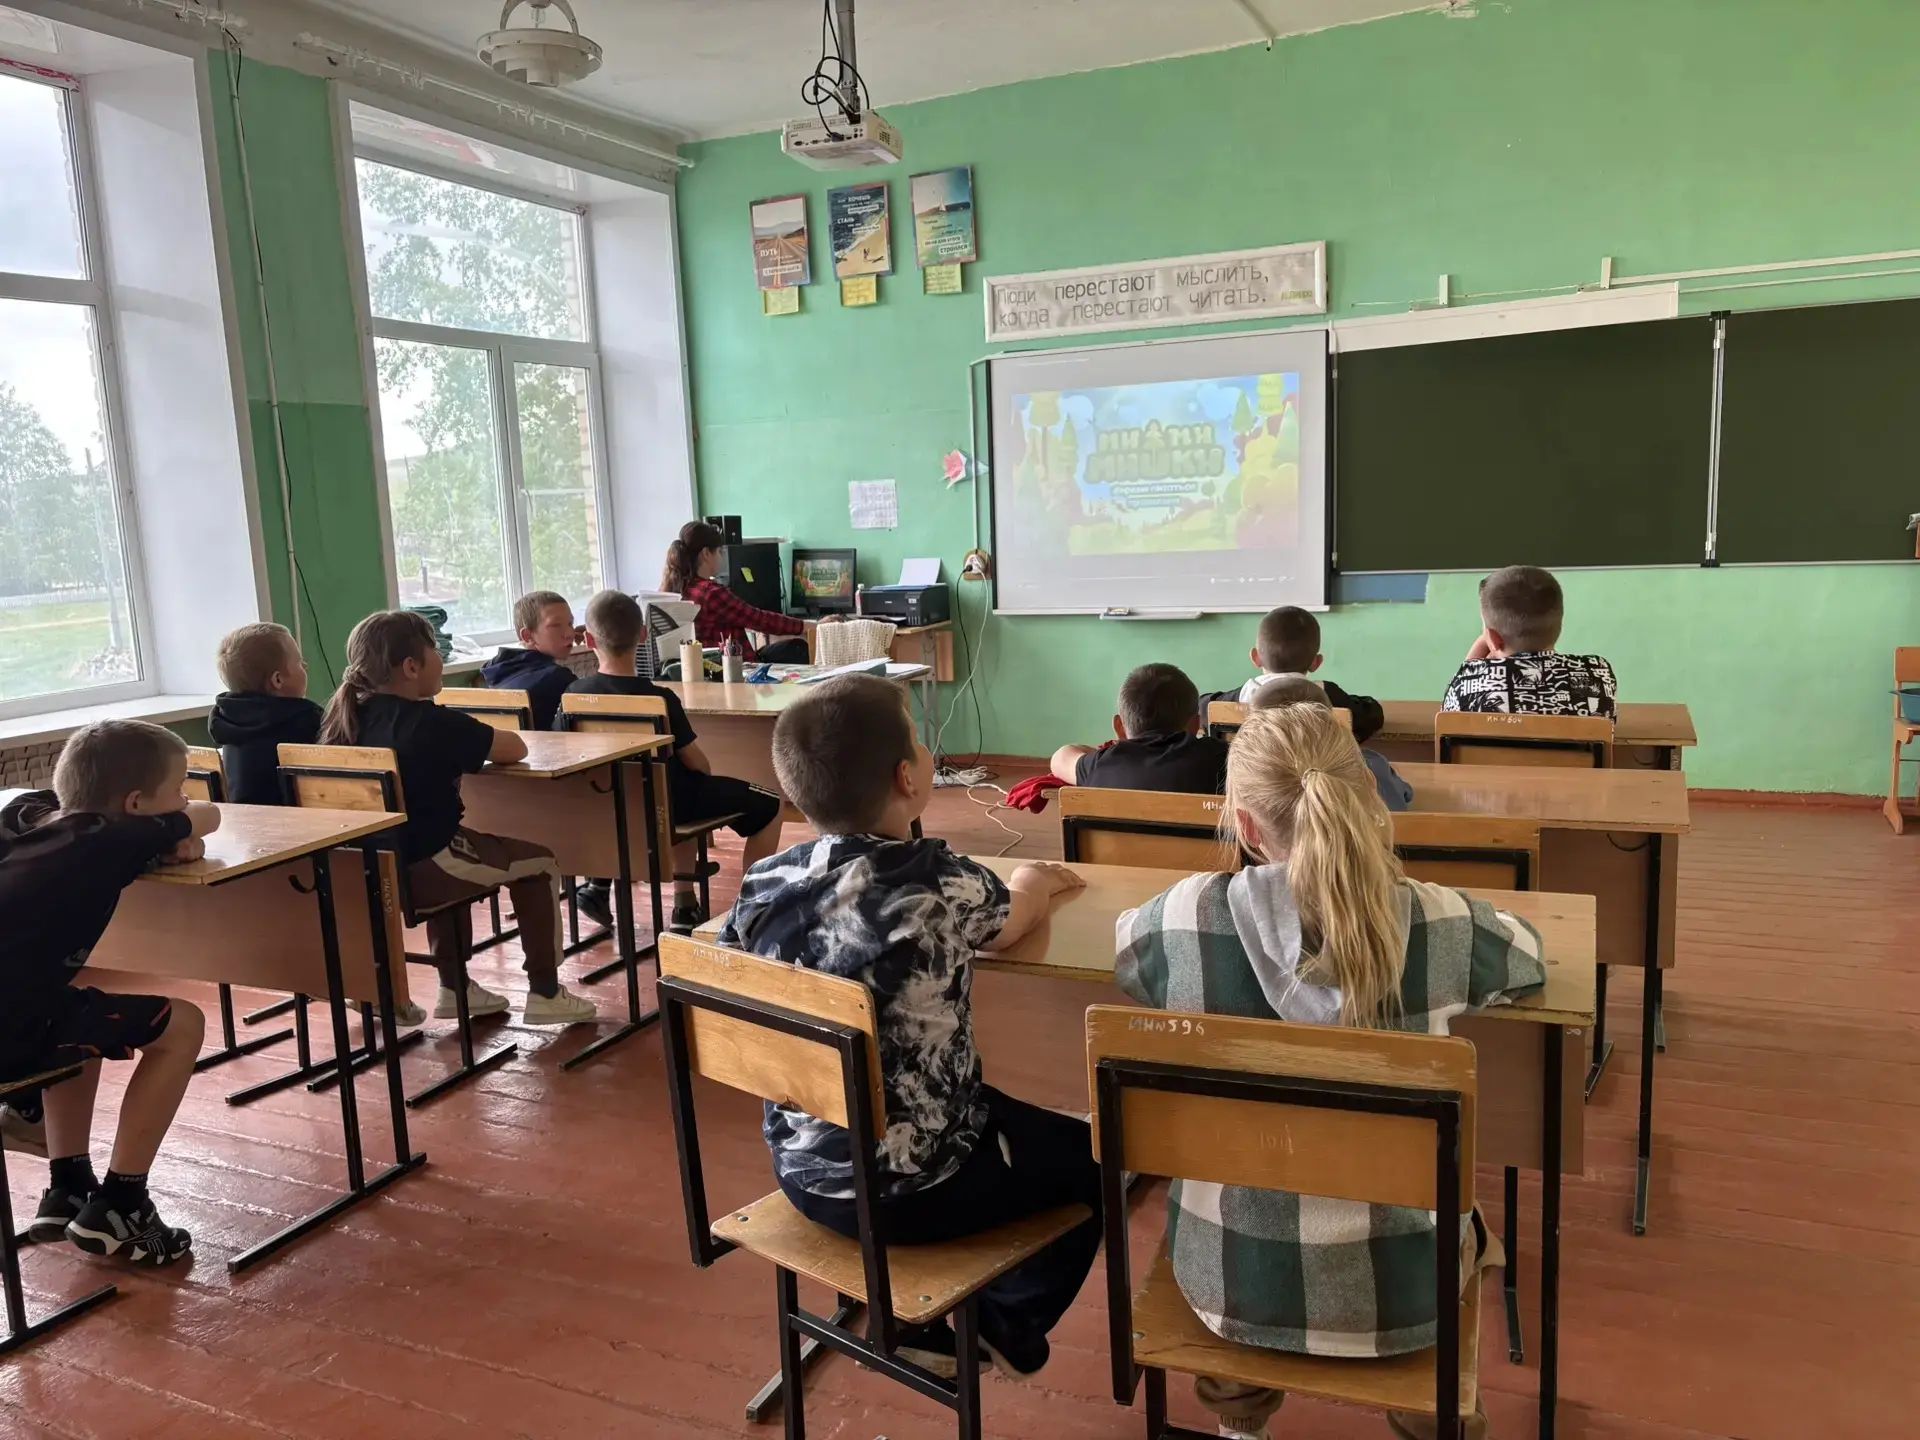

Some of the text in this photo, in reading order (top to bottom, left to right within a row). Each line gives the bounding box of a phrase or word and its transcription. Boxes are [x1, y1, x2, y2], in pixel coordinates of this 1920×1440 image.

[1054, 275, 1155, 302] перестают
[1176, 265, 1268, 287] мыслить,
[999, 288, 1266, 328] когда перестают читать.
